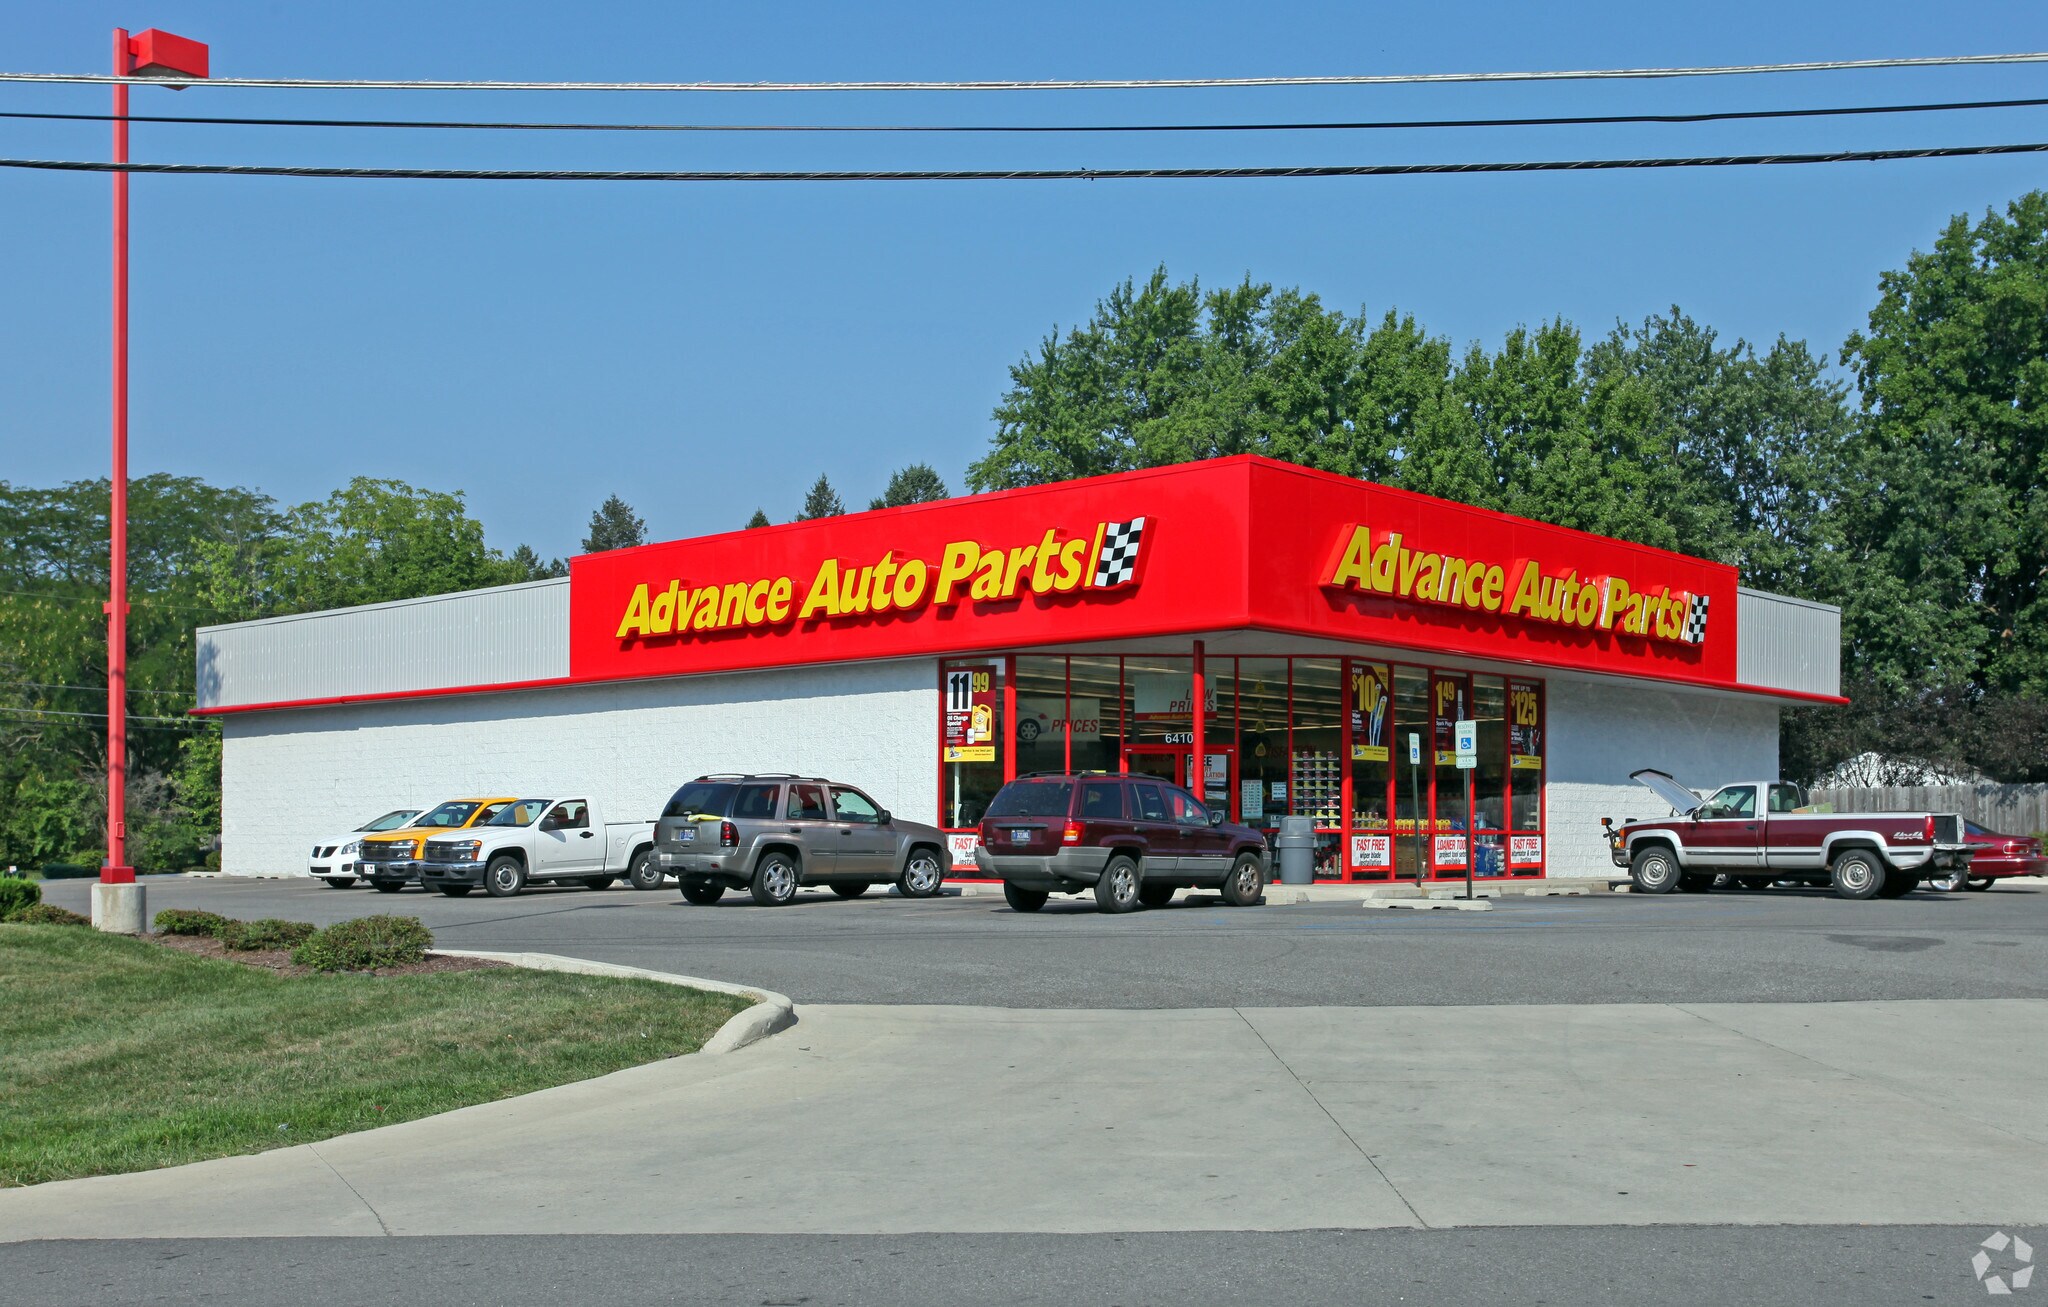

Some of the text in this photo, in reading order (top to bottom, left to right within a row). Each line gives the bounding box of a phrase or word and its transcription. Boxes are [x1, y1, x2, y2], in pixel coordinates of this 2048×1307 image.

[616, 528, 1087, 639] Advance Auto Parts
[1331, 525, 1685, 641] Advance Auto Parts
[1352, 667, 1363, 675] SAVE
[950, 672, 990, 710] 11 99
[1185, 688, 1214, 701] LW
[1169, 700, 1215, 712] PRIS
[1165, 733, 1194, 744] 6410
[954, 838, 973, 850] FAST
[1356, 839, 1386, 851] FAST FREE
[1437, 839, 1456, 851] LOANER
[1513, 838, 1538, 850] FAST FREE
[1371, 851, 1381, 859] blade
